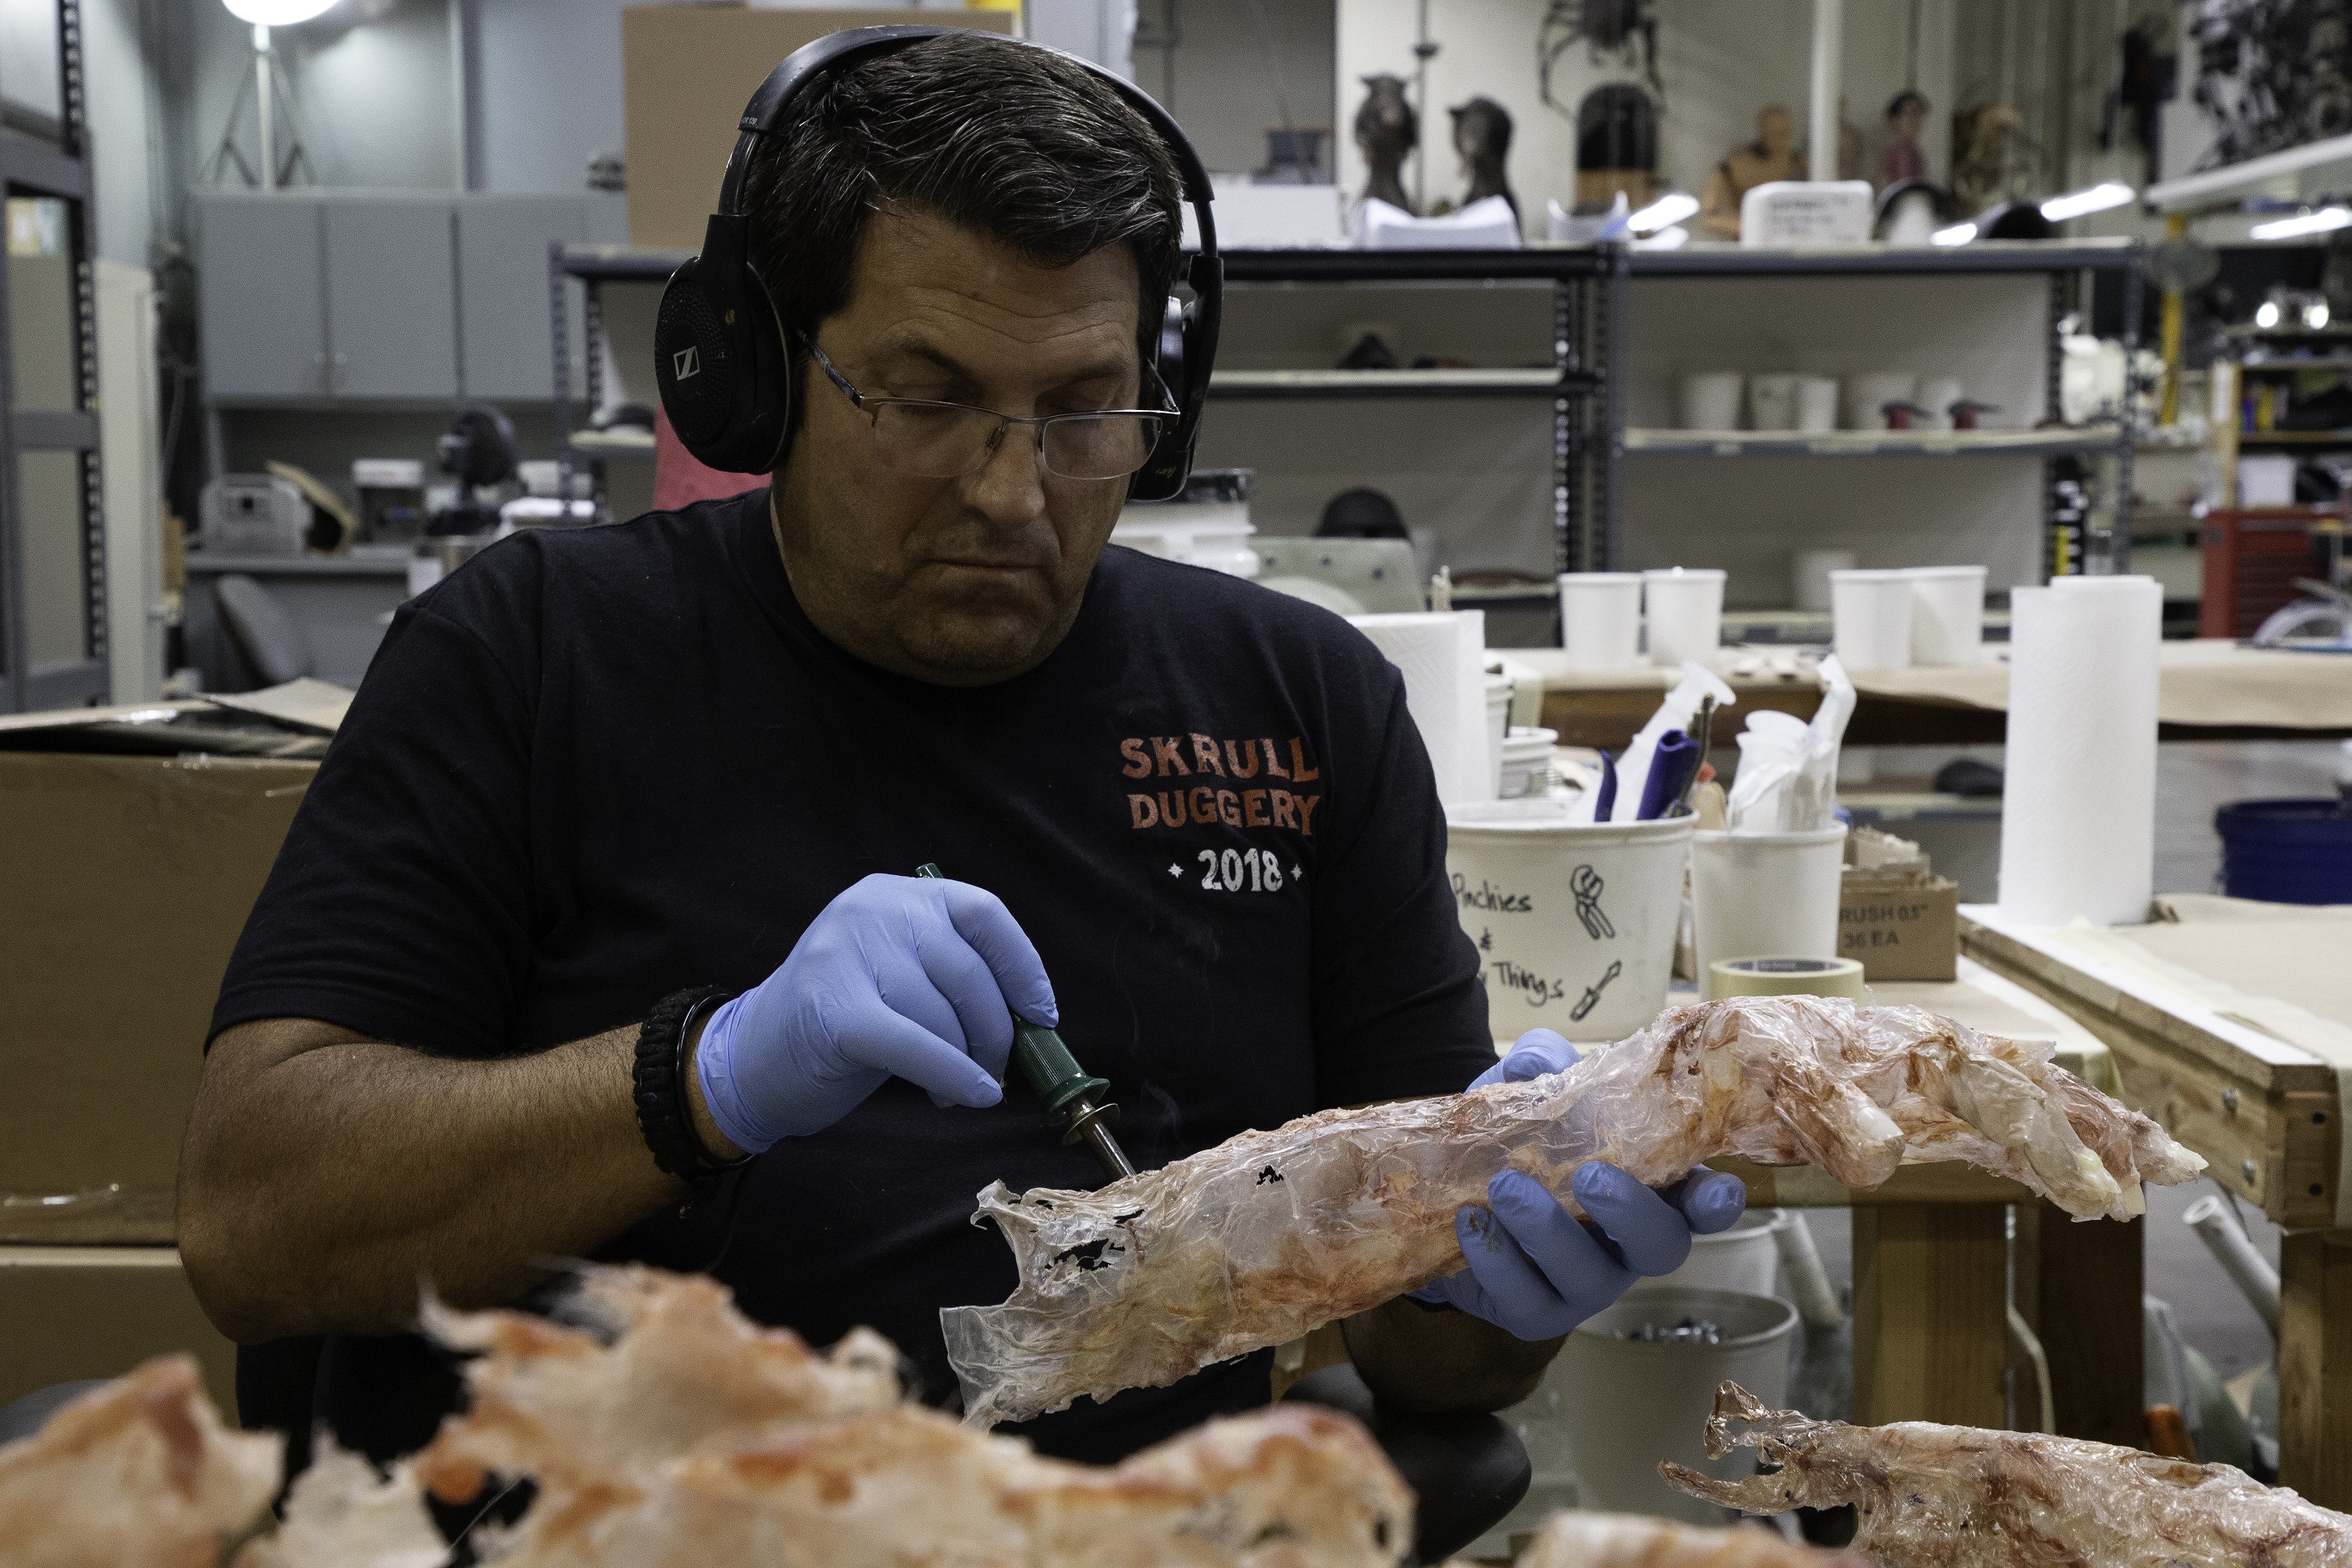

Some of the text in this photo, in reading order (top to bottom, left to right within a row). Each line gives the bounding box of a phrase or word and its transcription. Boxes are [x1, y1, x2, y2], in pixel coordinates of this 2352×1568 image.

[1120, 732, 1319, 782] SKRULL
[1127, 787, 1320, 836] DUGGERY
[1197, 848, 1283, 892] 2018
[1491, 960, 1565, 1008] Things
